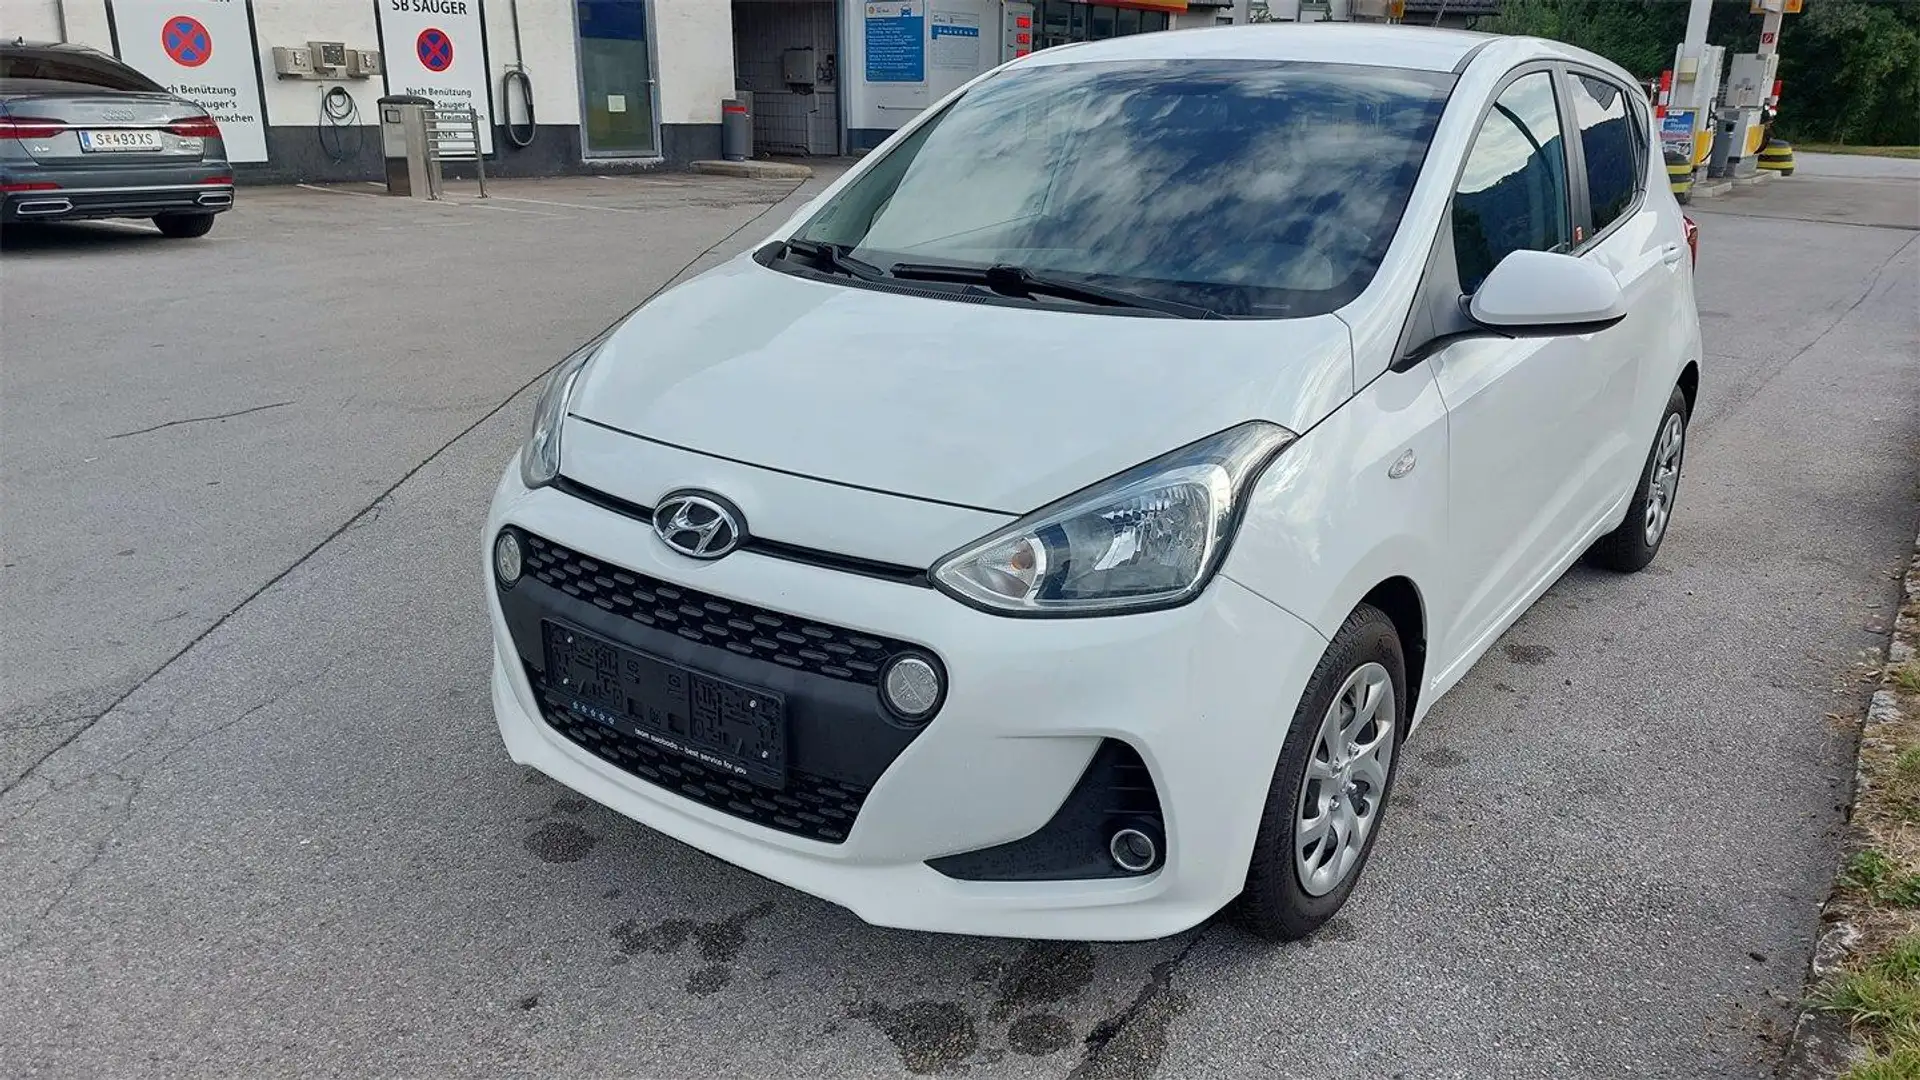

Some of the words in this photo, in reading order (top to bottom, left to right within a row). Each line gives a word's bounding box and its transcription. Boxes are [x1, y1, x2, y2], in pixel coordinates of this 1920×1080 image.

[392, 0, 409, 11] SB
[413, 0, 467, 14] SAUGER
[406, 87, 427, 96] Nach
